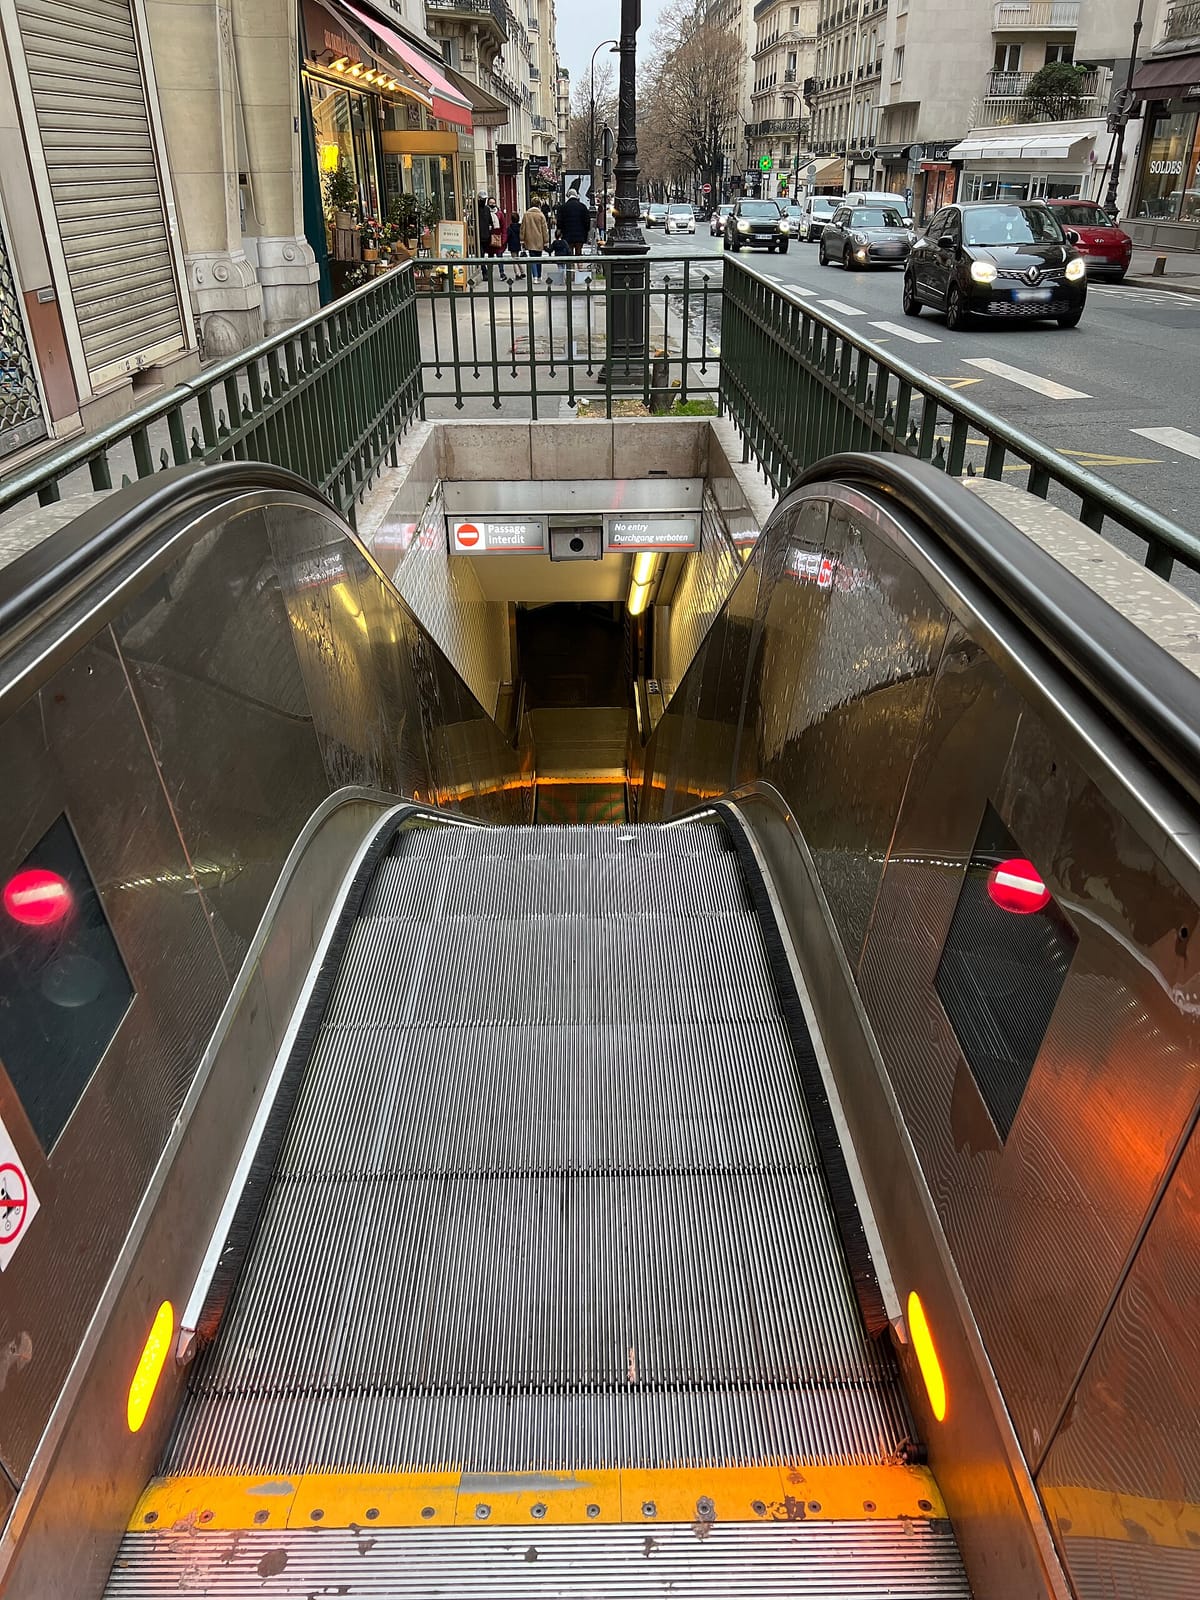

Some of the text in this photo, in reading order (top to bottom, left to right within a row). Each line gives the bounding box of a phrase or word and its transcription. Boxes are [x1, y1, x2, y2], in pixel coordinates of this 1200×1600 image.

[1150, 160, 1182, 174] SOLDES
[488, 524, 526, 535] Passage
[614, 523, 649, 532] No entry
[488, 535, 525, 544] interdit
[614, 534, 689, 543] Durchgang verboten
